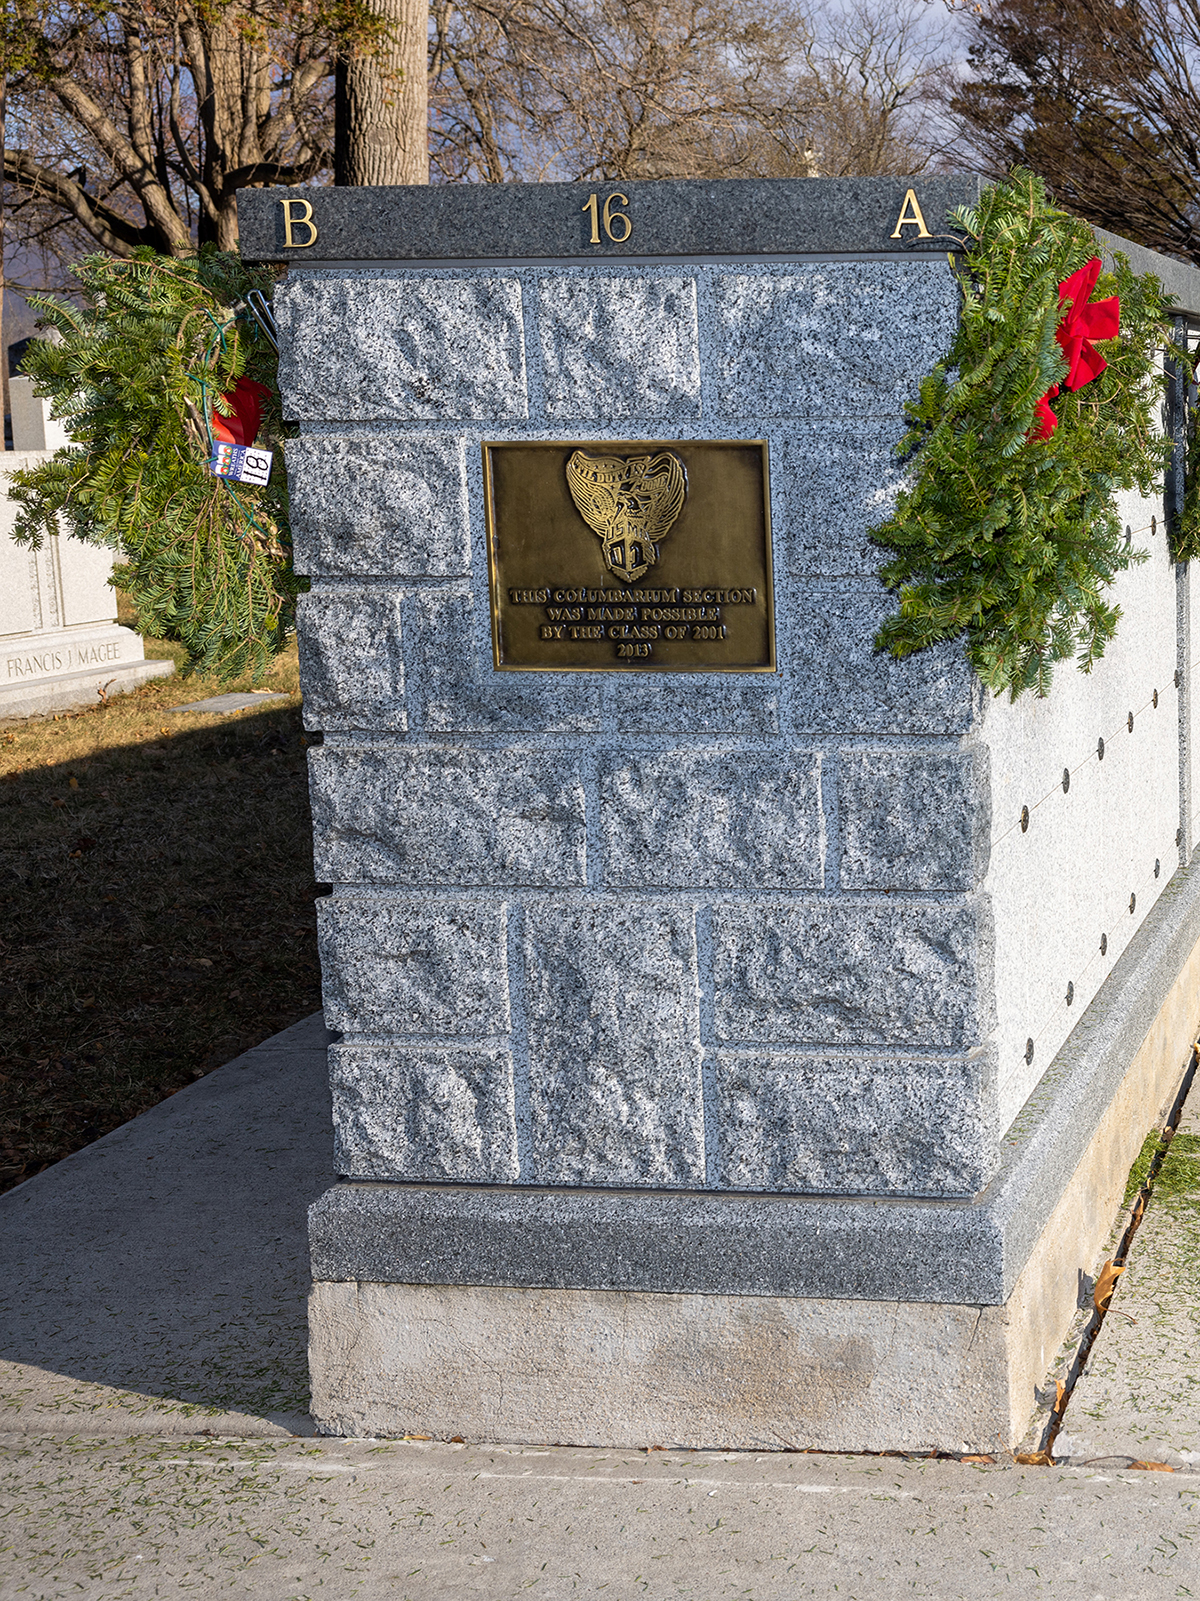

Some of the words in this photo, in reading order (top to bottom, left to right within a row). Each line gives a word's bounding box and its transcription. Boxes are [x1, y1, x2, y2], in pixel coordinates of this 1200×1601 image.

[280, 199, 317, 248] B
[582, 192, 631, 243] 16
[890, 189, 932, 238] A
[243, 455, 269, 481] 18
[509, 588, 548, 603] THIS
[553, 588, 677, 603] COLUMBARIUM
[682, 588, 754, 603] SECTION
[546, 607, 581, 621] WAS
[587, 607, 635, 621] MADE
[641, 607, 718, 621] POSSIBLE
[541, 625, 563, 639] BY
[568, 625, 601, 639] THE
[607, 625, 659, 639] CLASS
[664, 625, 687, 639] OF
[692, 625, 724, 639] 2001
[617, 643, 649, 657] 2013
[7, 651, 63, 678] FRANCIS
[67, 649, 72, 670] J
[78, 641, 121, 665] MAGEE
